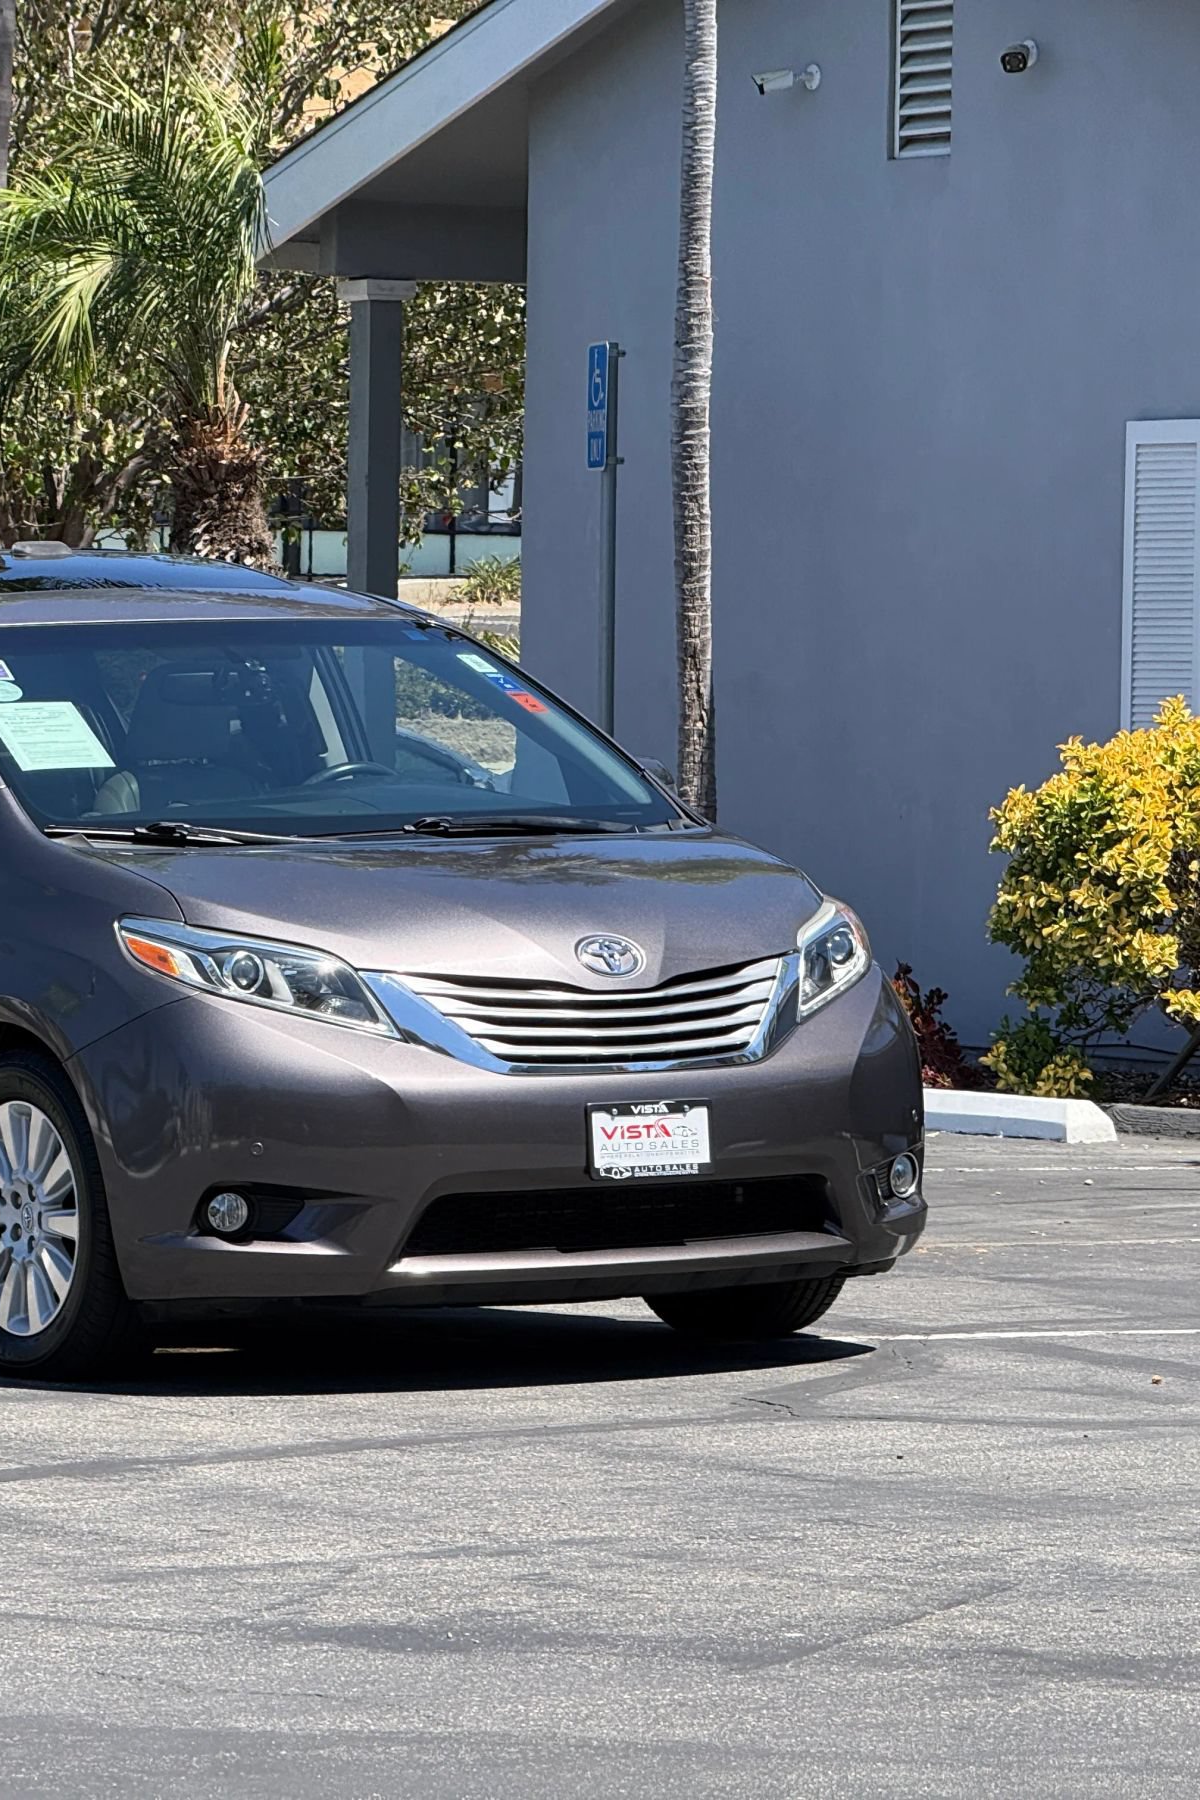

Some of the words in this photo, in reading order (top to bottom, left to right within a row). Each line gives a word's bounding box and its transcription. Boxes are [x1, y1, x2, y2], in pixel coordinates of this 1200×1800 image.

[631, 1103, 670, 1115] VISTA
[600, 1123, 673, 1140] VISTA
[600, 1142, 644, 1152] AUTO
[649, 1139, 700, 1150] SALES
[664, 1163, 699, 1172] SALES
